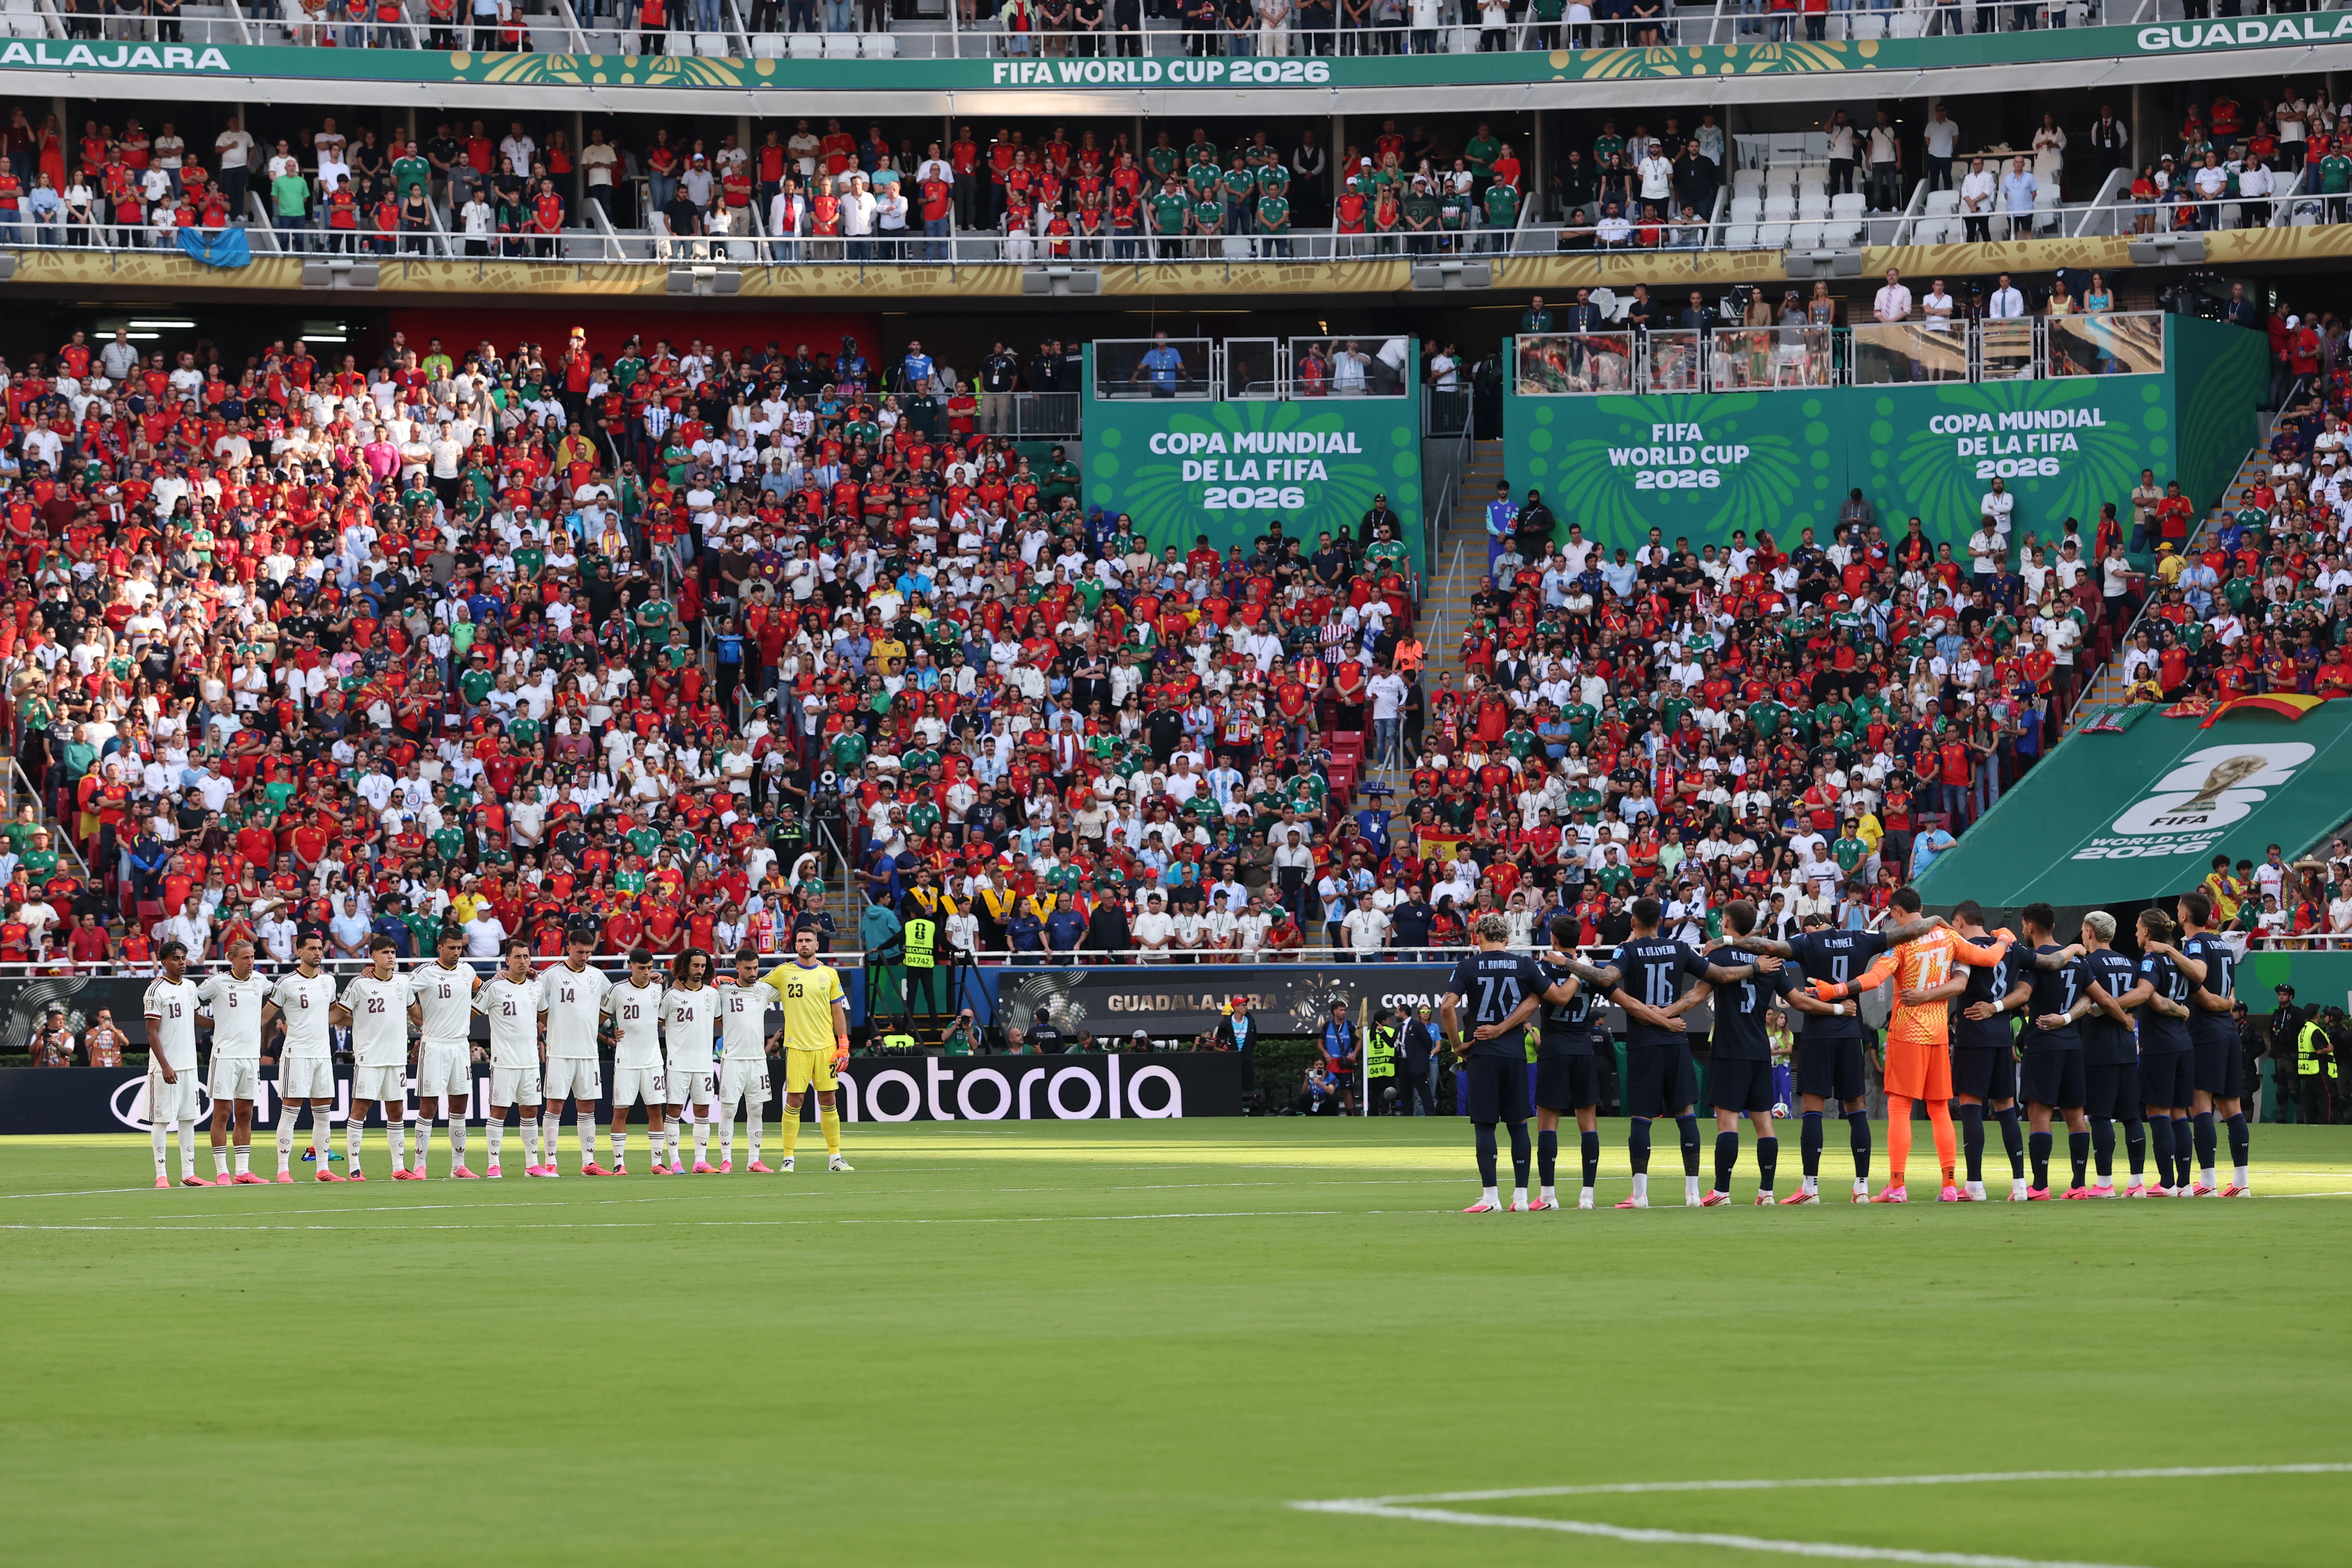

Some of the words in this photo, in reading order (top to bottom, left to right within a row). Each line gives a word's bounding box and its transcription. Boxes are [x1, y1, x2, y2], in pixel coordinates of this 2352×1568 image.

[994, 63, 1054, 83] FIFA
[1058, 61, 1162, 83] WORLD
[1168, 61, 1224, 82] CUP
[1230, 61, 1330, 82] 2026
[1930, 414, 1994, 434] COPA
[1999, 408, 2106, 430] MUNDIAL
[1653, 423, 1703, 442] FIFA
[1150, 433, 1227, 454] COPA
[1234, 432, 1361, 454] MUNDIAL
[1958, 437, 1987, 456] DE
[1993, 436, 2022, 454] LA
[2027, 433, 2078, 452] FIFA
[1608, 447, 1695, 466] WORLD
[1701, 446, 1749, 464] CUP
[1183, 461, 1218, 481] DE
[1225, 460, 1260, 480] LA
[1267, 460, 1327, 480] FIFA
[1976, 458, 2059, 479] 2026
[1636, 470, 1720, 489] 2026
[1204, 487, 1305, 509] 2026
[2149, 815, 2209, 826] FIFA
[2091, 835, 2175, 847] WORLD
[2176, 831, 2224, 842] CUP
[2071, 841, 2211, 860] 2026
[907, 956, 930, 965] 04742
[1644, 962, 1674, 1007] 16
[1991, 960, 2008, 1001] 8
[438, 984, 451, 999] 16
[560, 988, 575, 1003] 14
[787, 983, 803, 998] 23
[2060, 969, 2076, 1014] 3
[229, 993, 238, 1008] 5
[300, 994, 309, 1009] 6
[367, 998, 385, 1013] 22
[729, 998, 744, 1012] 15
[1382, 994, 1431, 1008] COPA
[1476, 976, 1522, 1022] 20
[168, 1003, 182, 1019] 19
[502, 1001, 517, 1016] 21
[623, 1004, 640, 1019] 20
[676, 1007, 694, 1022] 24
[653, 1076, 665, 1090] 20
[760, 1074, 771, 1090] 15
[782, 1054, 1182, 1122] motorola
